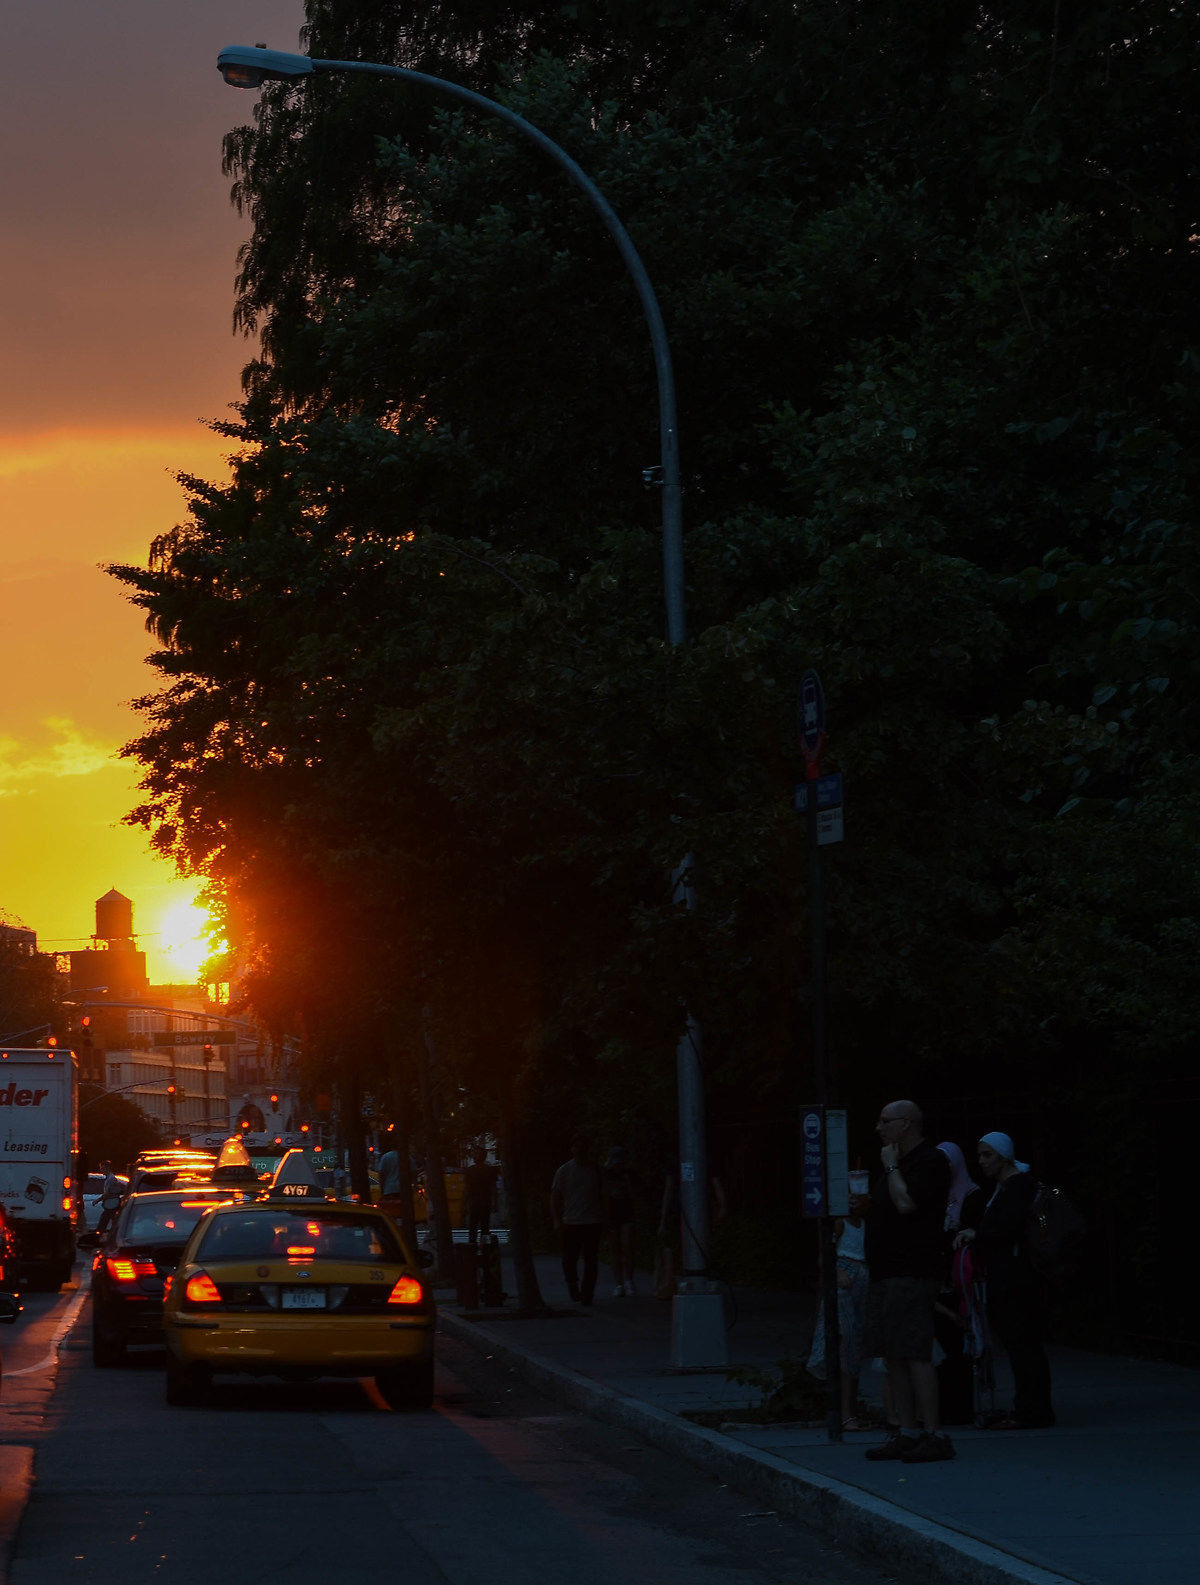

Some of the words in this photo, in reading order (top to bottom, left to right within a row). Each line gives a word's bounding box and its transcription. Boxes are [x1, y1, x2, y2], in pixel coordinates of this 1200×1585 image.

[175, 1034, 215, 1044] Bowery
[3, 1141, 48, 1154] Leasing
[283, 1185, 309, 1196] 4Y67
